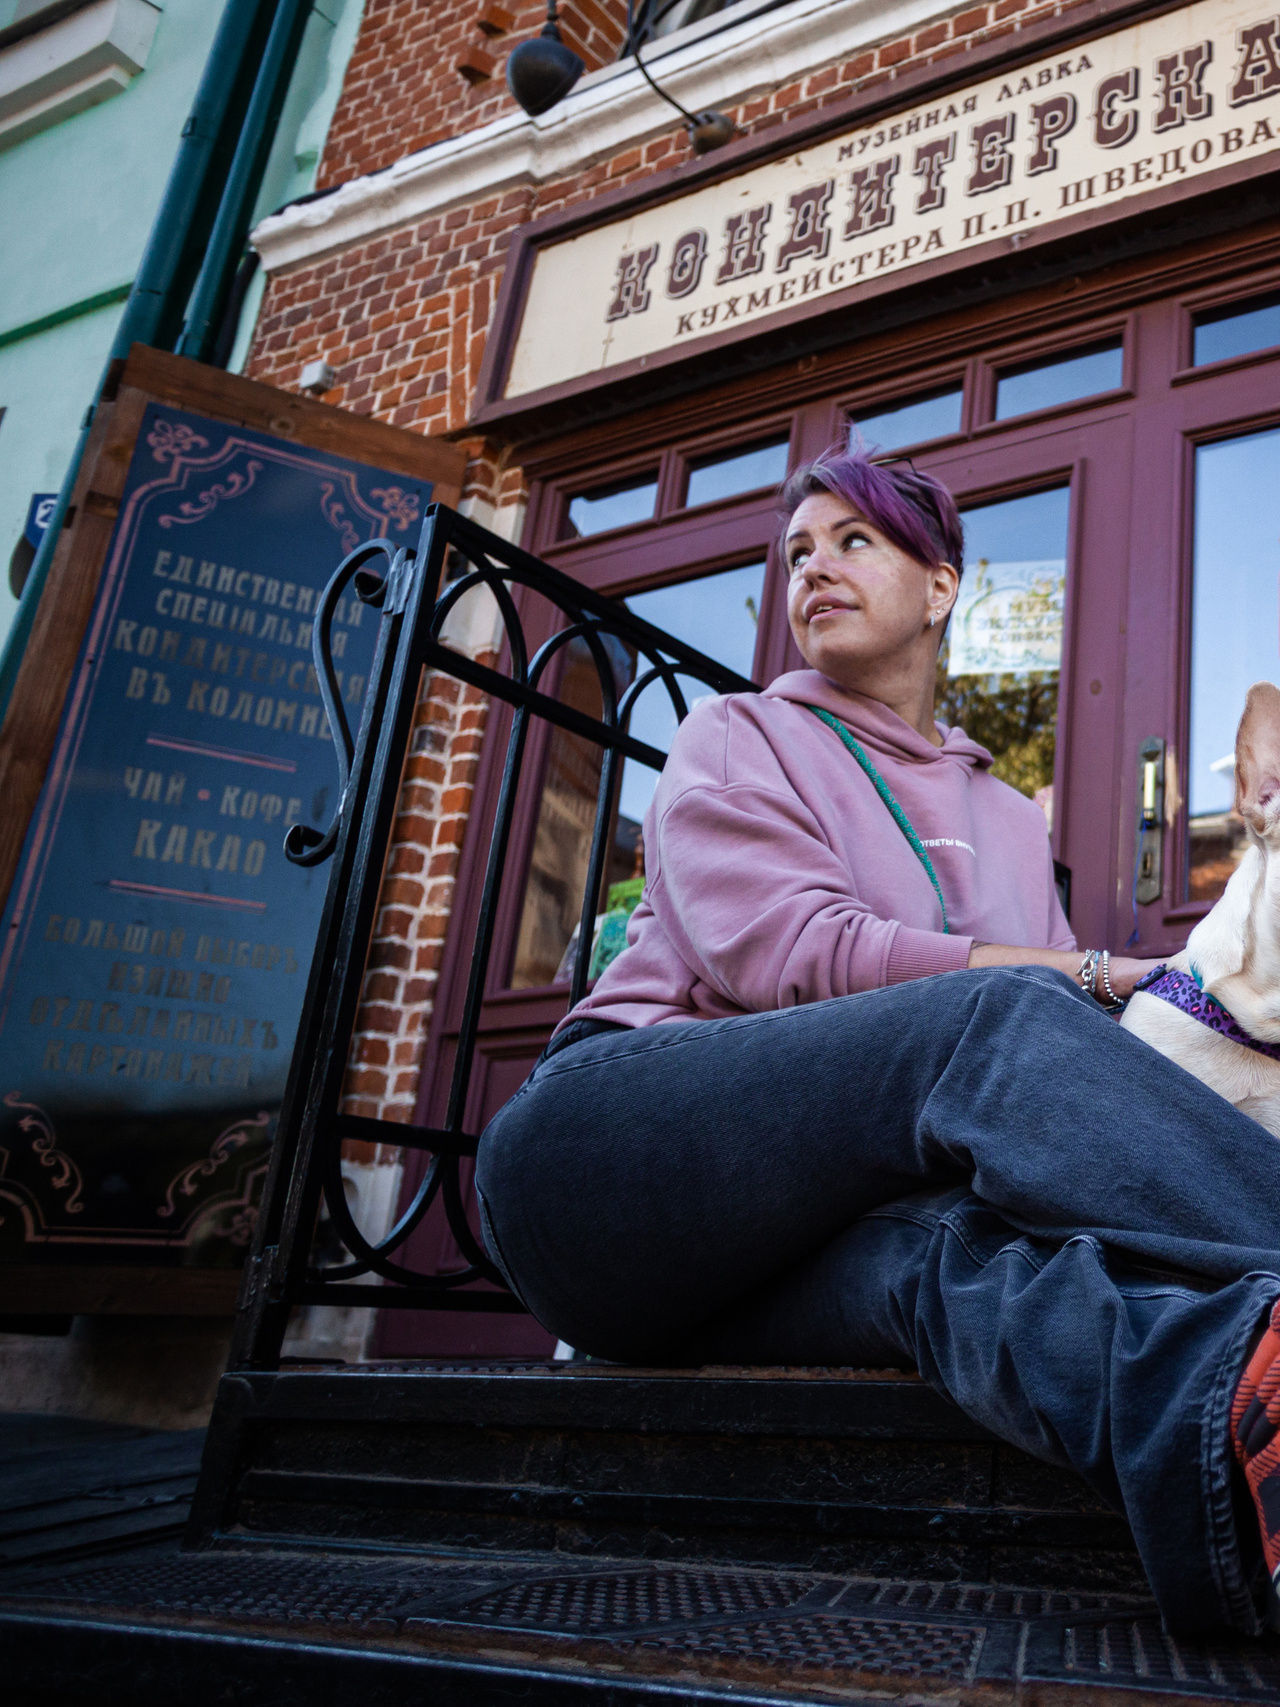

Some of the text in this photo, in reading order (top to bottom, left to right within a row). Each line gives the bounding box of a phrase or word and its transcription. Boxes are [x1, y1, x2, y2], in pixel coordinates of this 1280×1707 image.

[837, 54, 1094, 163] МУЗЕЙНАЯ ЛАВКА
[674, 226, 947, 337] КУХМЕЙСТЕРА
[961, 198, 1042, 242] П.П.
[155, 588, 348, 658] СПЕЦІАЛЬНЯ
[125, 666, 171, 706] ВЪ
[123, 766, 301, 827] ЧАЙ КОФЕ
[132, 818, 267, 877] КАКАО
[43, 914, 187, 959] БОЛЬШОЙ
